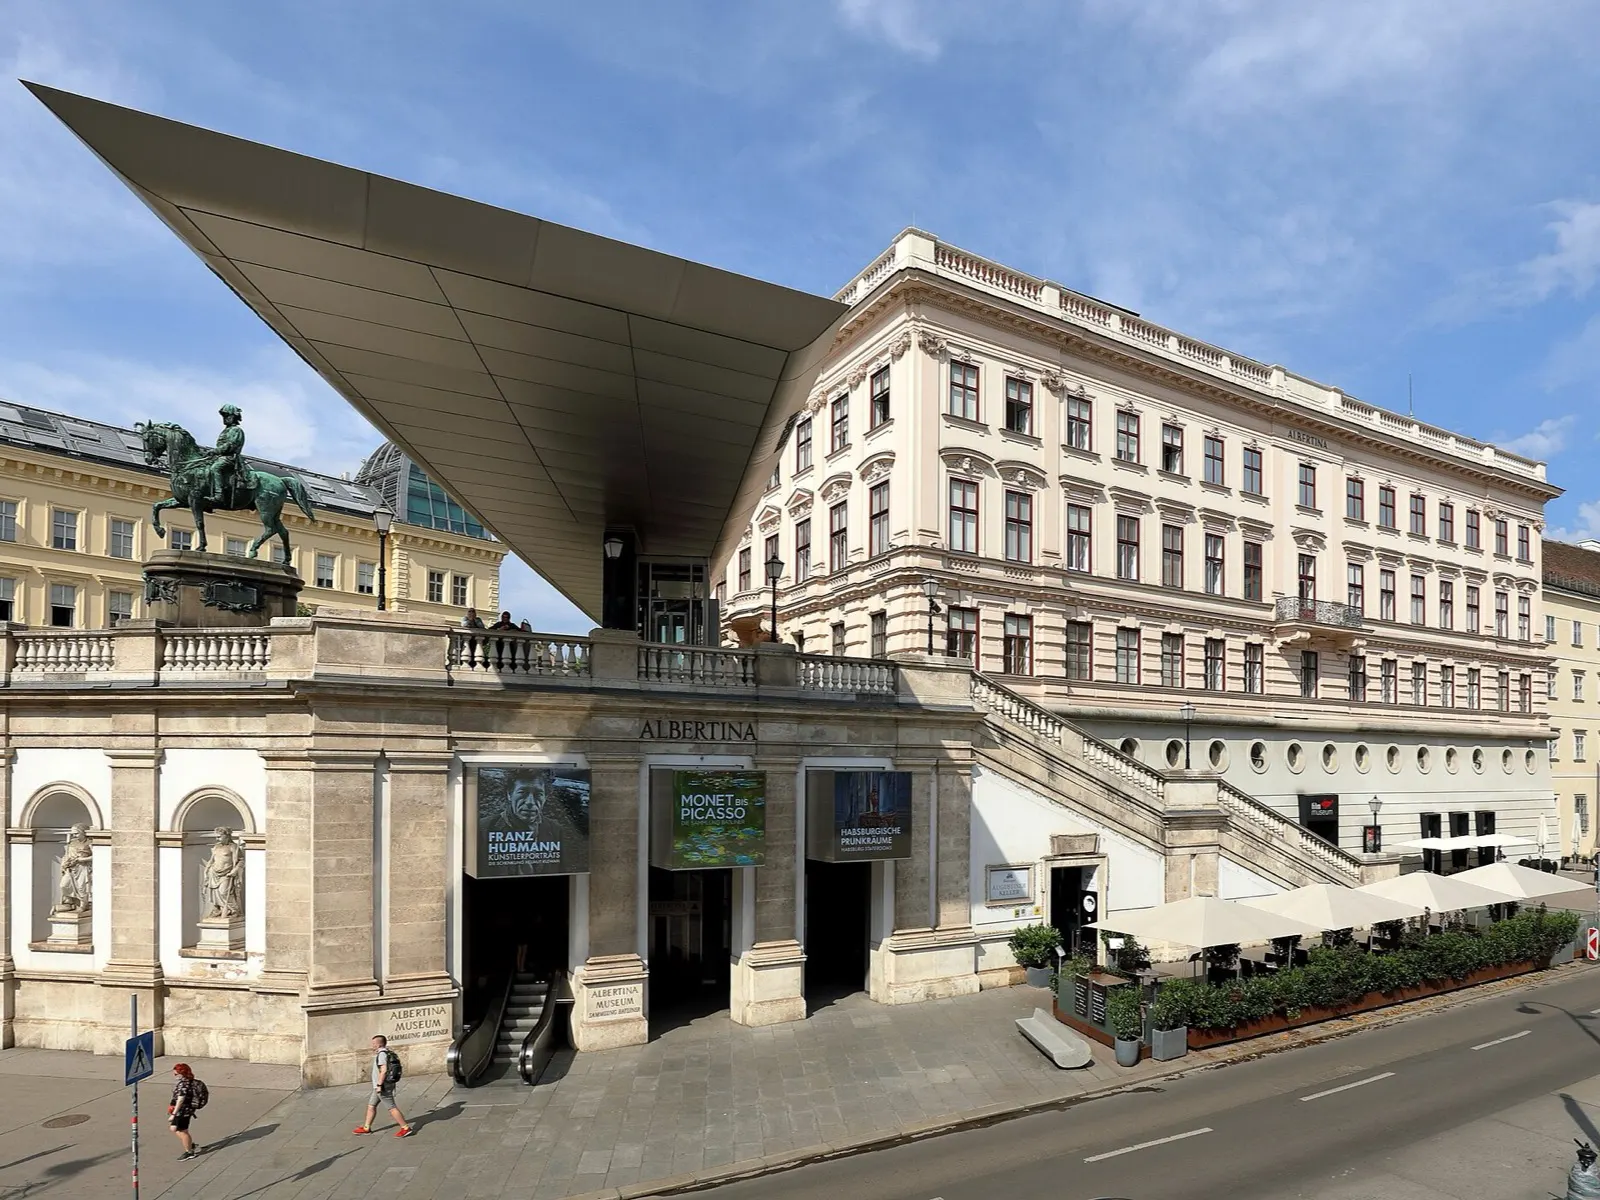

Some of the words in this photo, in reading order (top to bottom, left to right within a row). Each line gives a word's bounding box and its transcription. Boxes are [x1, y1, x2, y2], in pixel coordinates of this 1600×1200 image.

[1287, 429, 1328, 450] ALBERTINA
[639, 719, 758, 741] ALBERTINA
[681, 794, 735, 807] MONET
[735, 798, 749, 806] BIS
[681, 807, 746, 820] PICASSO
[488, 831, 534, 842] FRANZ
[840, 826, 902, 836] HABSBURGISCHE
[840, 835, 893, 846] PRUNKRÄUME
[488, 841, 561, 853] HUBMANN
[488, 851, 561, 861] KÜNSTLERPORTRÄTS
[591, 986, 639, 999] ALBERTINA
[595, 997, 635, 1009] MUSEUM
[390, 1006, 447, 1021] ALBERTINA
[395, 1019, 442, 1032] MUSEUM
[386, 1031, 420, 1041] SAMMLUNG
